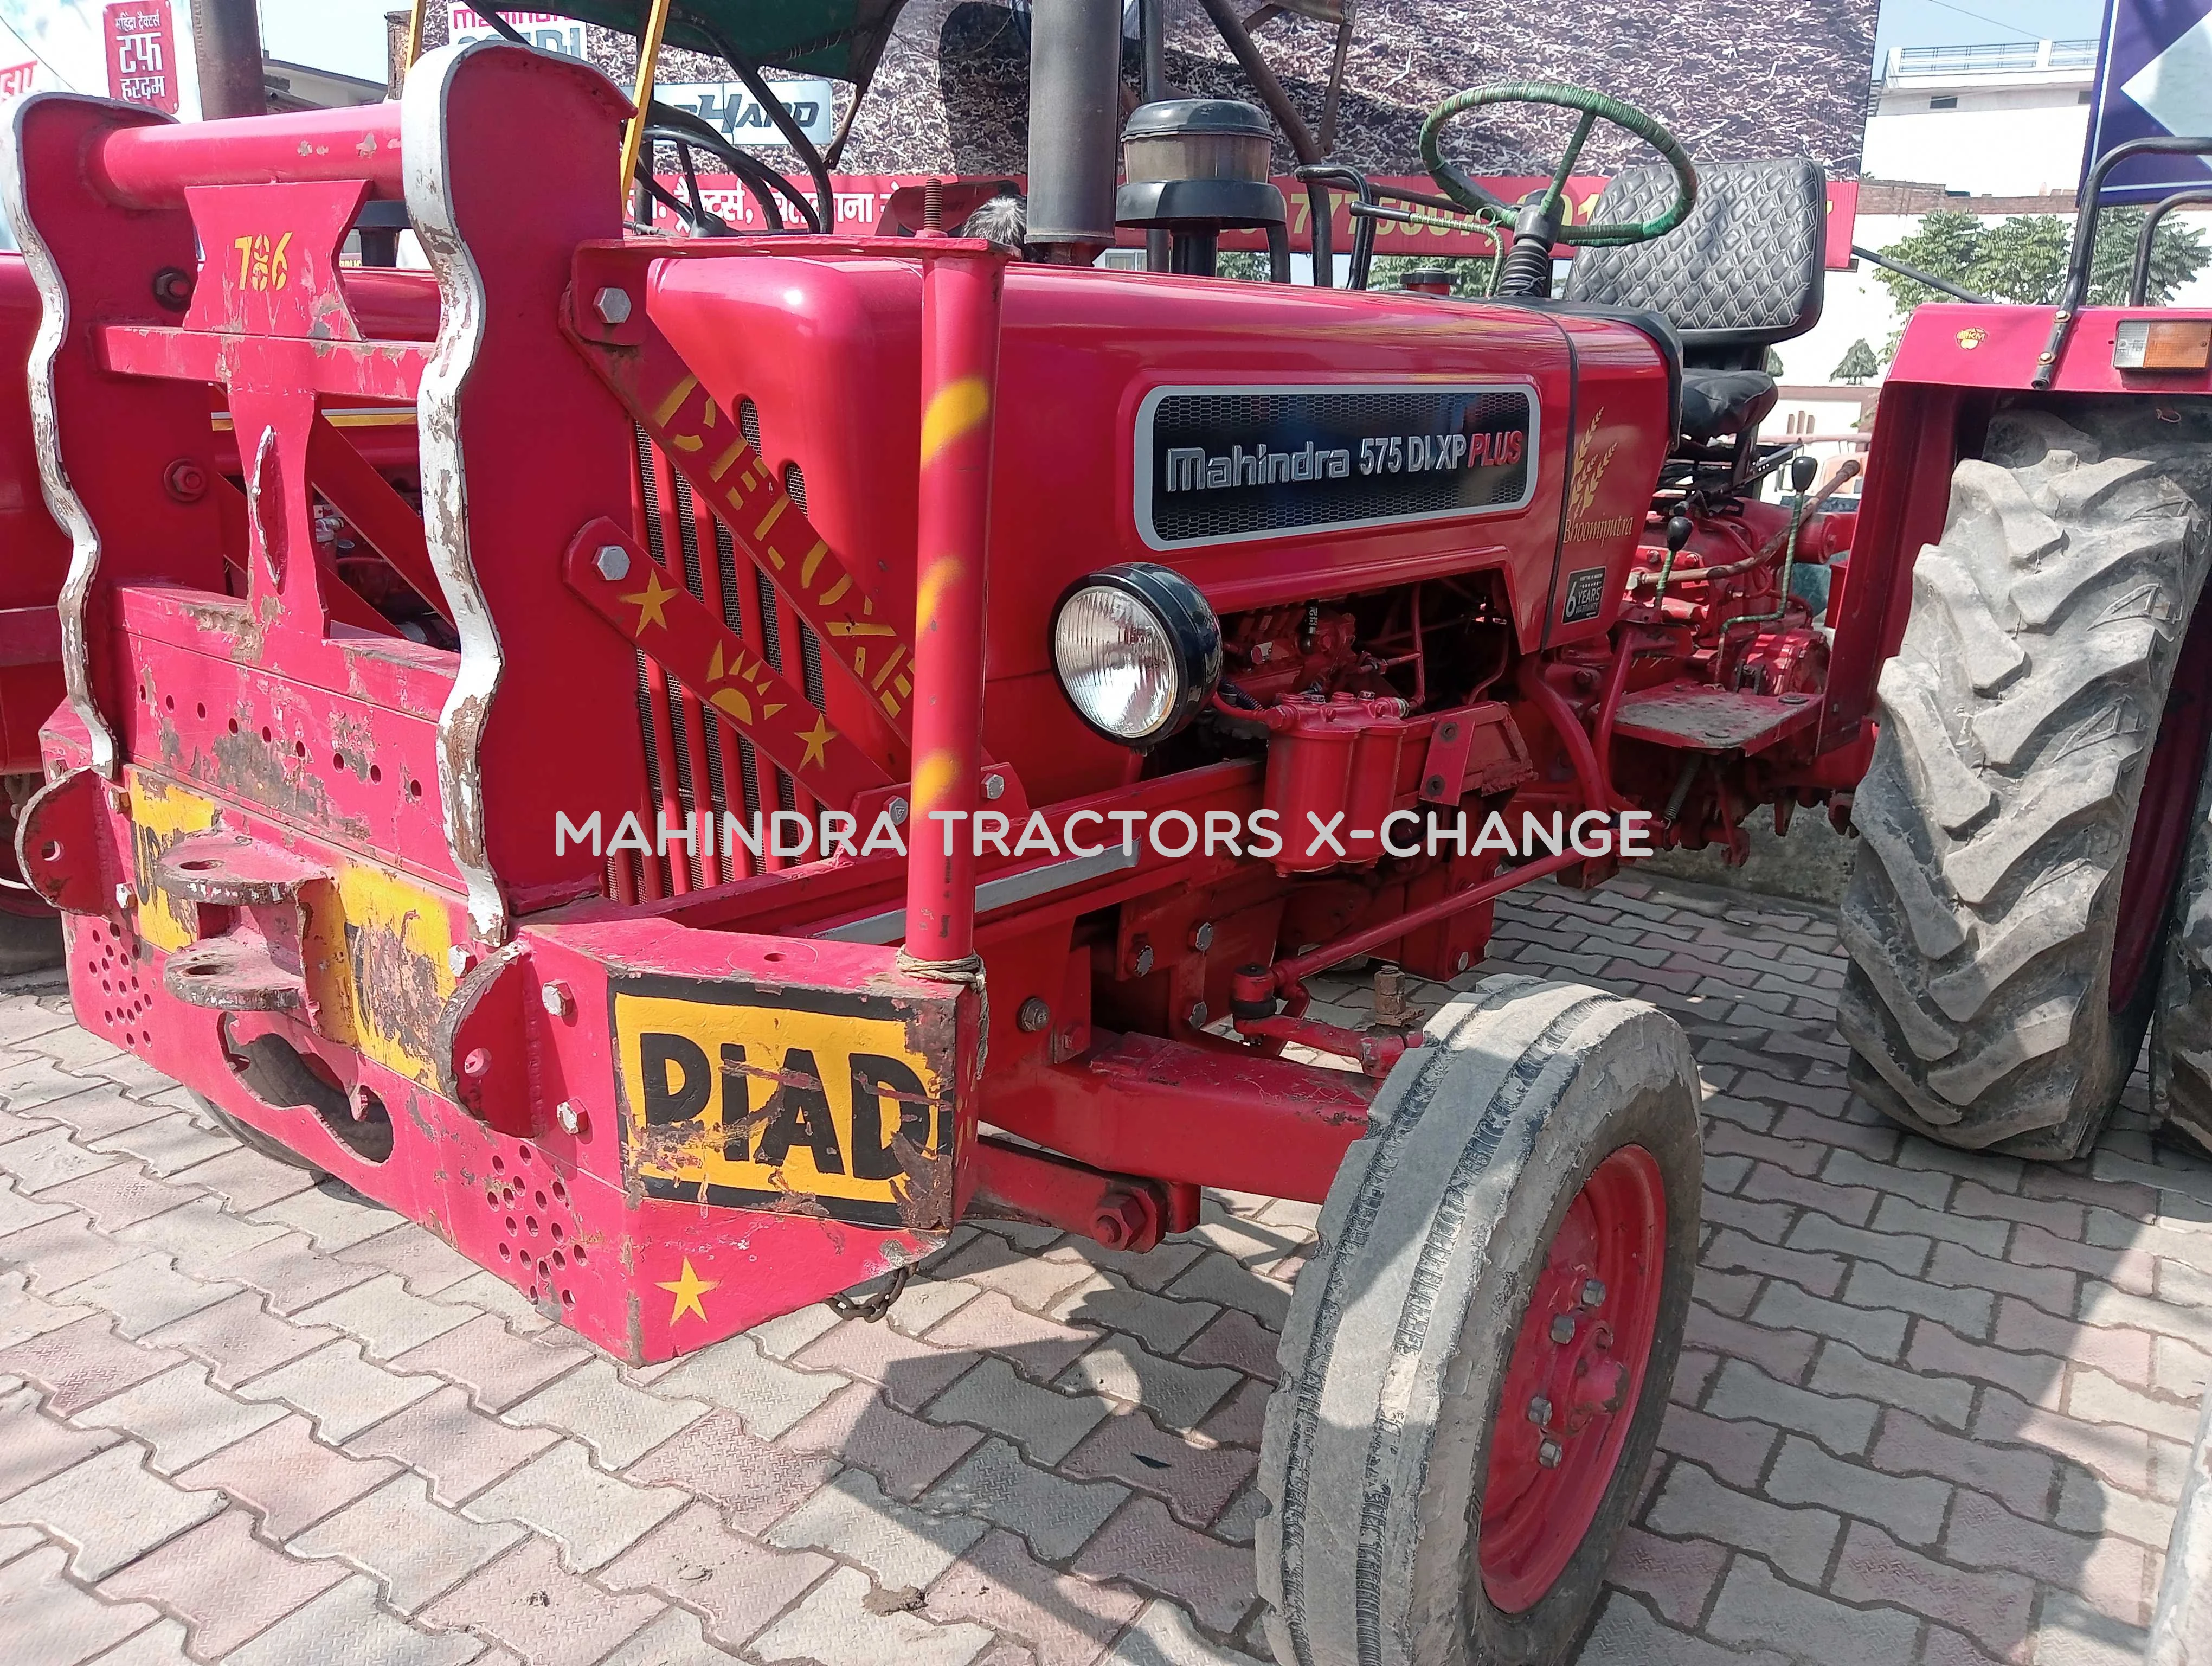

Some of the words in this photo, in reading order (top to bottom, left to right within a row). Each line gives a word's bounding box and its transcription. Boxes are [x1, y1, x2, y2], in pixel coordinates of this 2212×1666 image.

[120, 76, 165, 101] हरदम
[235, 232, 293, 291] 786
[1167, 440, 1350, 492] Mahindra
[1360, 437, 1402, 476] 575
[1436, 434, 1467, 470] XP
[1468, 430, 1523, 469] PLUS
[1563, 512, 1634, 548] Bhoomiputra
[1566, 581, 1577, 617] 6
